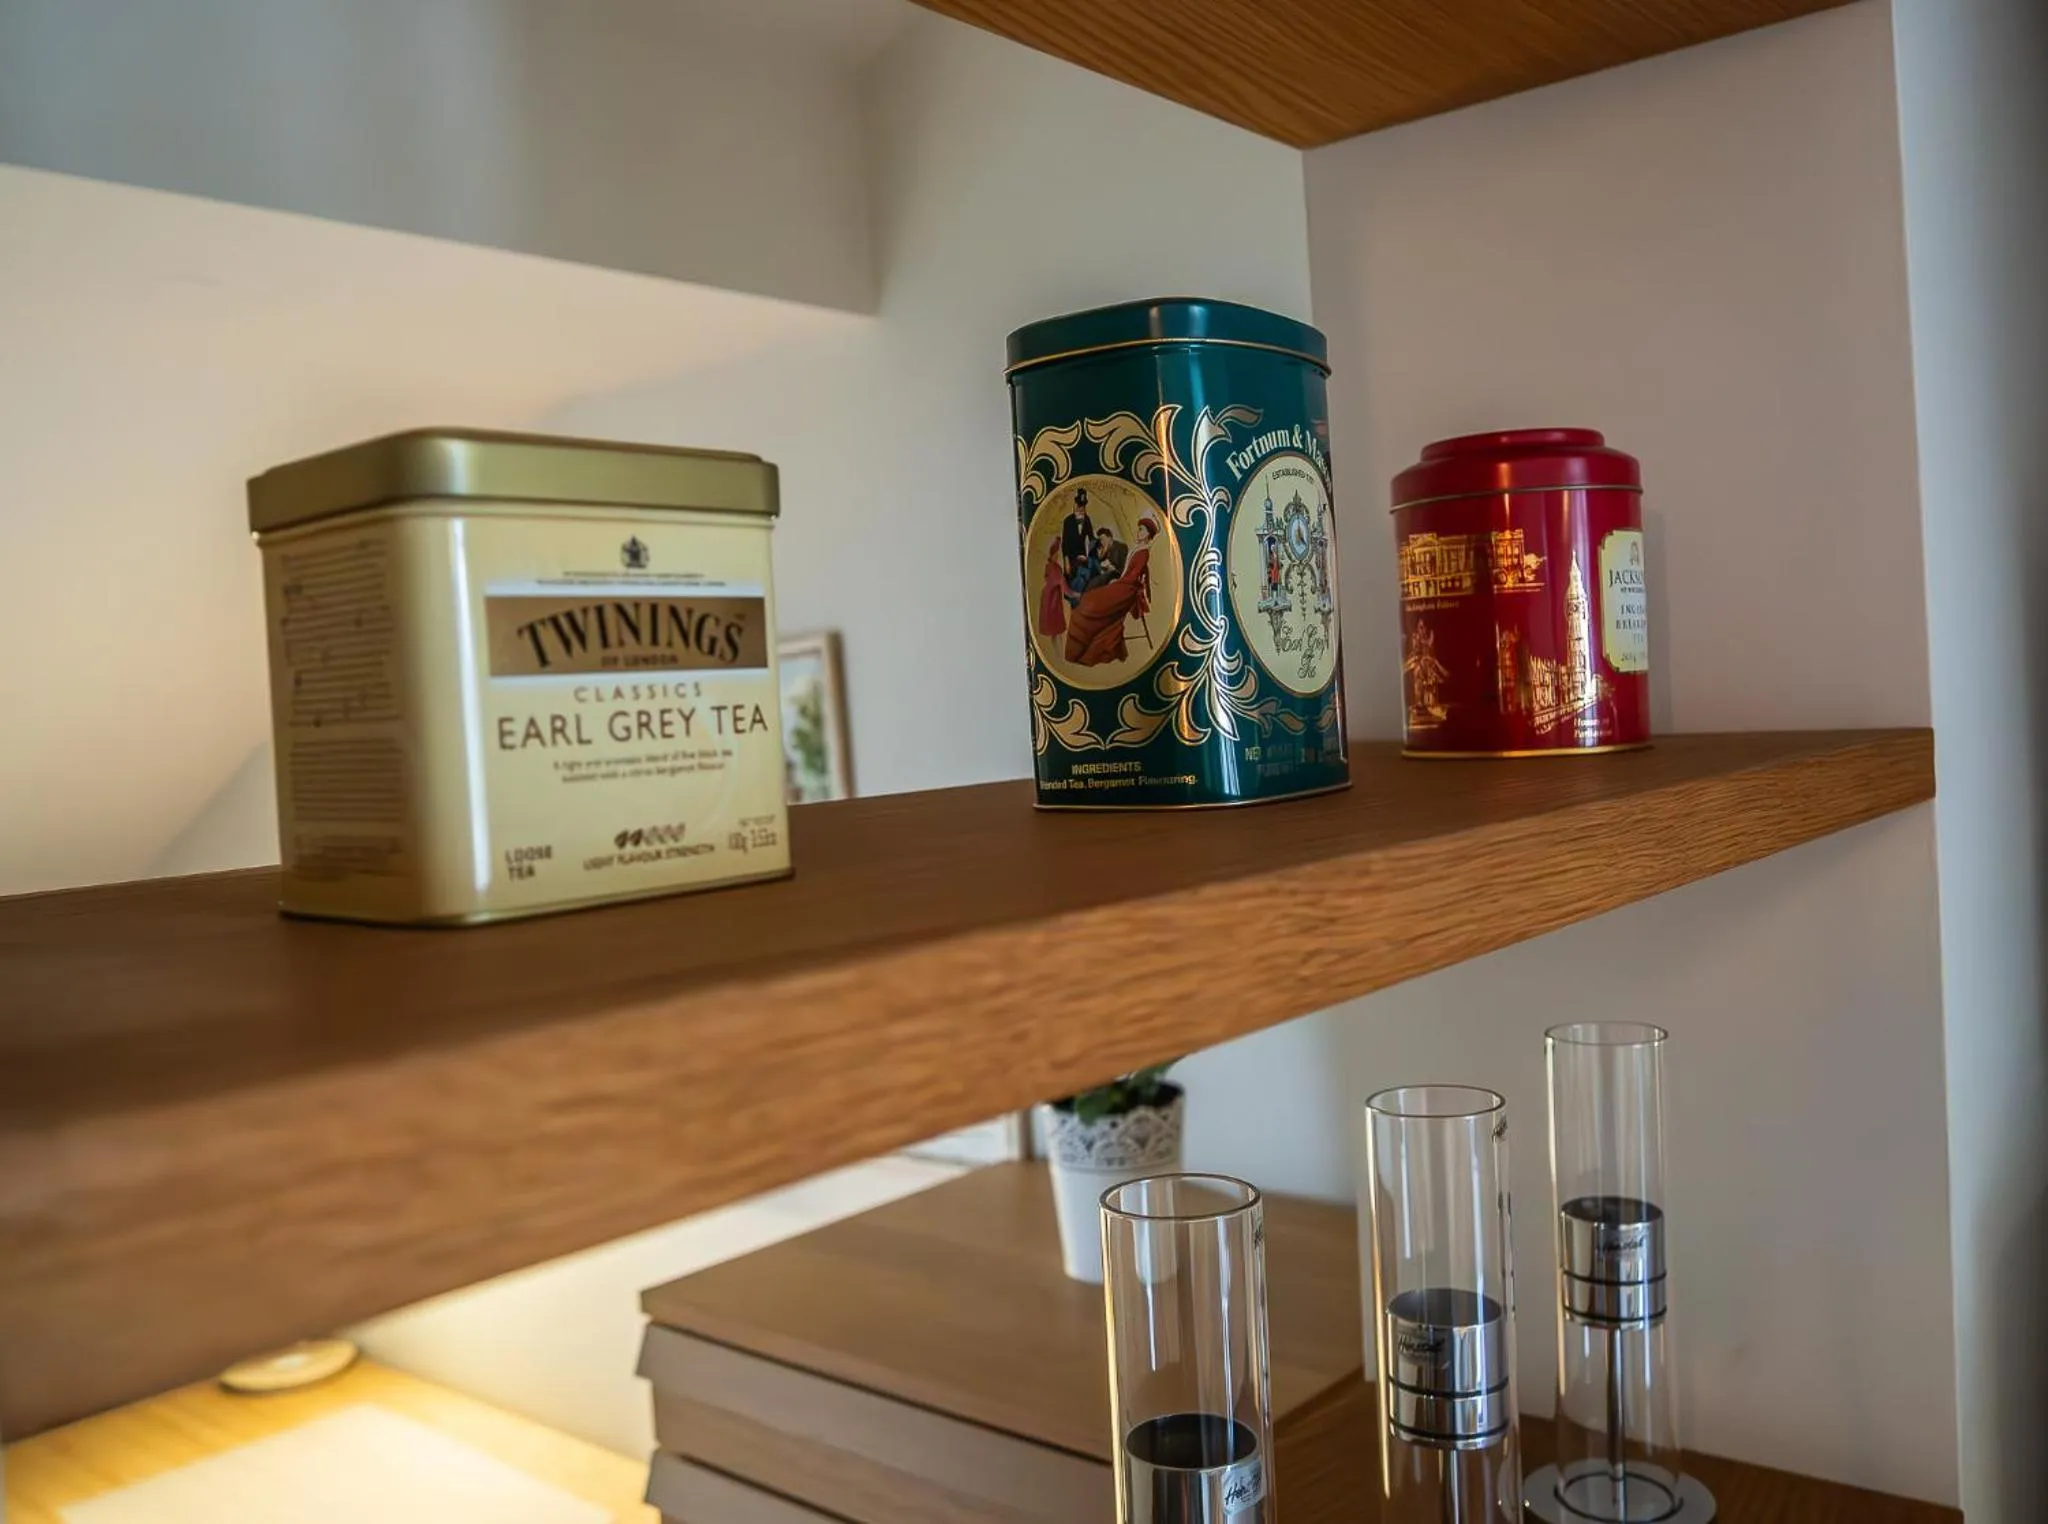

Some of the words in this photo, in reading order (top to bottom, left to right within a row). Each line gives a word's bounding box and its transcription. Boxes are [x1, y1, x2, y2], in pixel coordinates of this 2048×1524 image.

[1225, 429, 1291, 481] Fortnum
[1292, 423, 1303, 449] &
[517, 601, 744, 669] TWININGS
[574, 681, 702, 703] CLASSICS
[497, 713, 593, 751] EARL
[607, 706, 697, 743] GREY
[709, 703, 769, 735] TEA
[1087, 776, 1135, 790] Bergamot
[508, 864, 535, 881] TEA
